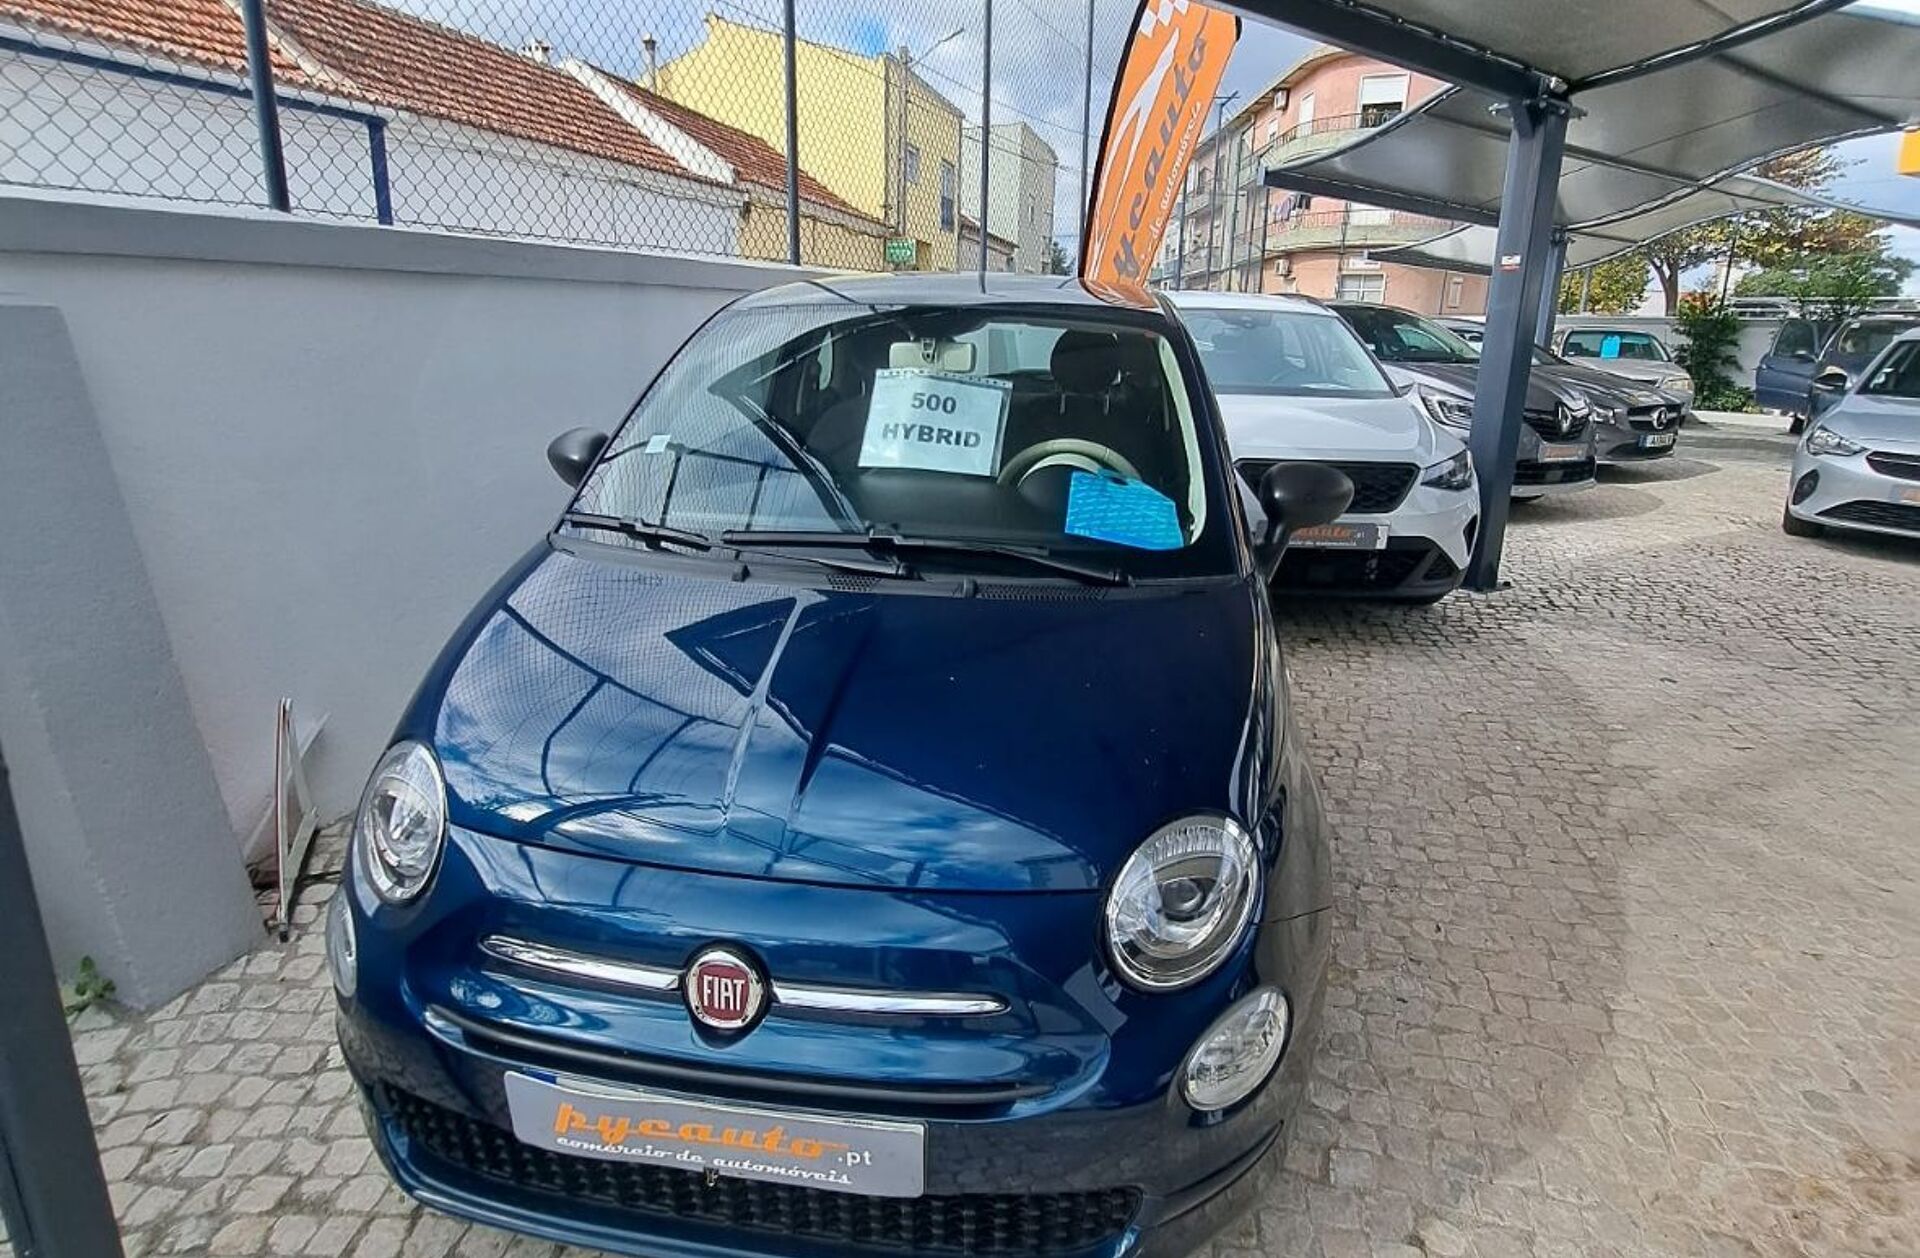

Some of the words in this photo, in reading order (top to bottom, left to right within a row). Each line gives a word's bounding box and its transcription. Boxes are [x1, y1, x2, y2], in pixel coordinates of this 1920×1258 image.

[1113, 8, 1209, 284] ycauto
[911, 392, 957, 415] 500
[882, 422, 982, 448] HYBRID
[703, 974, 745, 1011] FIAT
[553, 1102, 848, 1160] pycauto
[676, 1148, 704, 1164] de
[713, 1155, 852, 1185] automóveis
